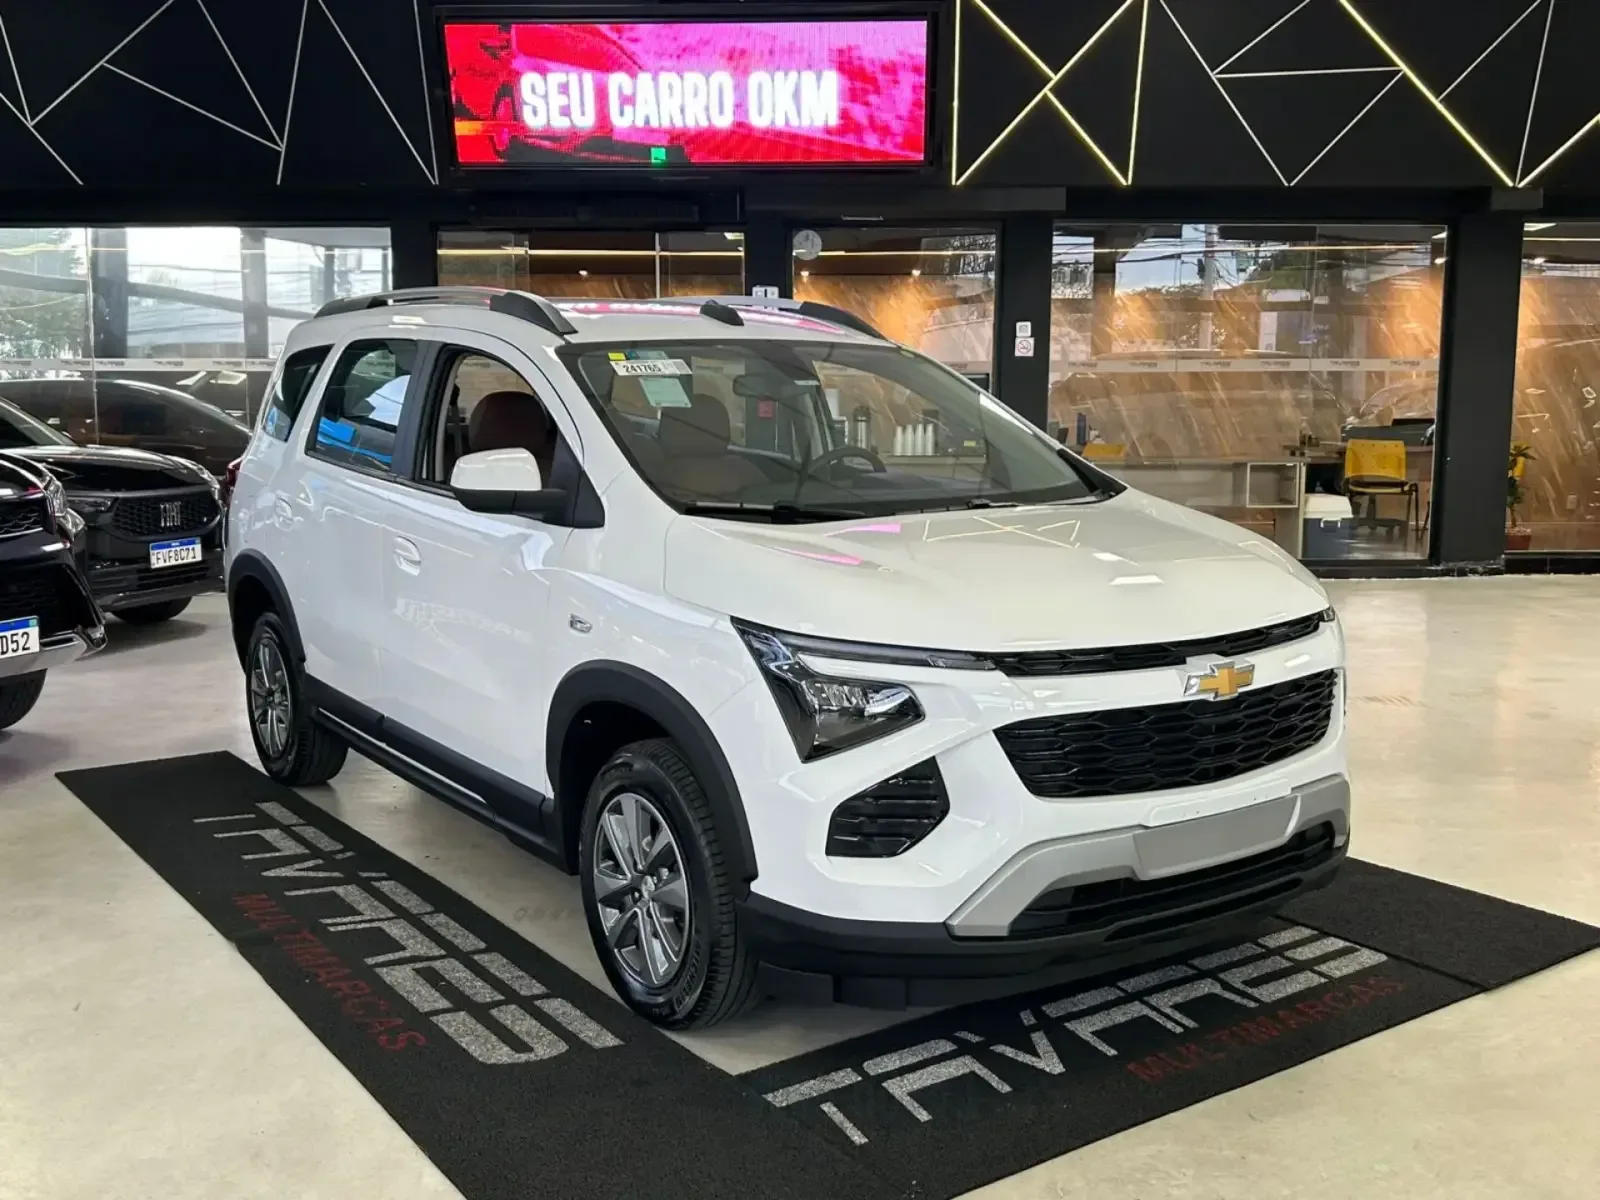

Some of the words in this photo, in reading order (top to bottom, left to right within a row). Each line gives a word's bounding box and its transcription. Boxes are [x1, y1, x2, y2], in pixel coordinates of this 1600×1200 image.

[520, 72, 596, 129] SEU
[607, 71, 736, 129] CARRO
[155, 547, 197, 565] FVF8C71
[160, 501, 182, 528] FIAT
[193, 801, 626, 1065] TAVARES
[231, 891, 429, 1053] MULTIMARCAS
[762, 925, 1388, 1147] TAVARES
[1126, 975, 1404, 1082] MULTIMARCAS
